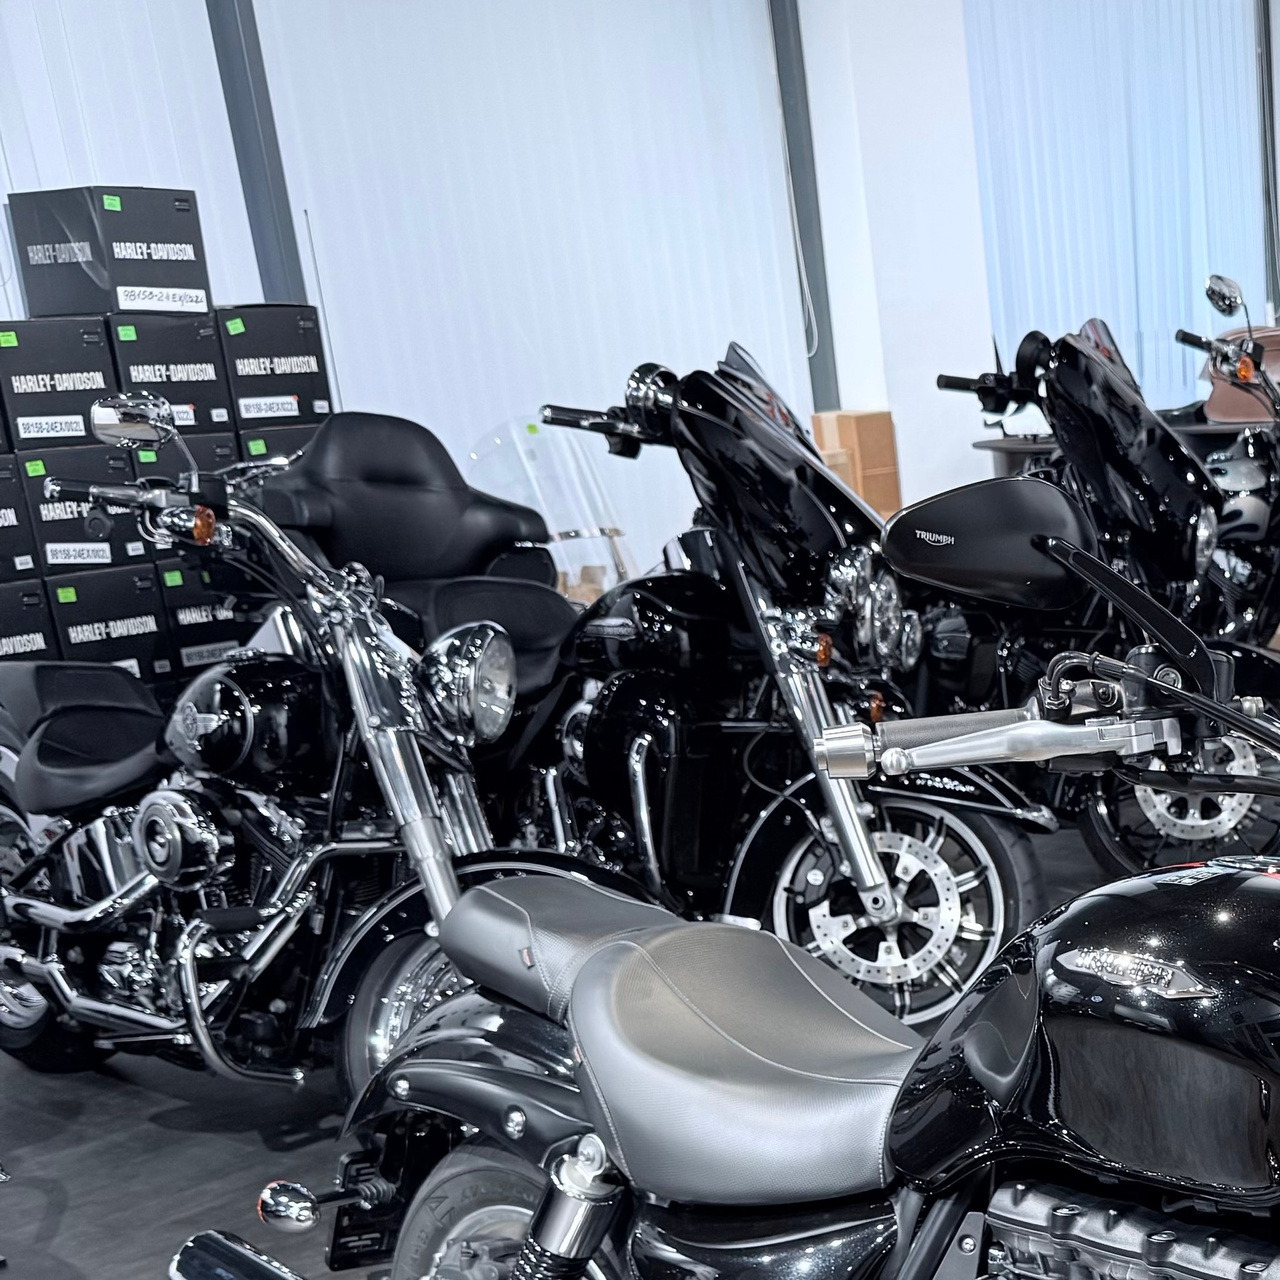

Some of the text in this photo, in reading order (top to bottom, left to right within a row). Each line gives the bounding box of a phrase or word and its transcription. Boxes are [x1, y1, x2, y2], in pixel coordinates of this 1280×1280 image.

[112, 241, 195, 261] HARLEY-DAVIDSON
[130, 363, 216, 383] HARLEY-DAVIDSON
[235, 356, 318, 376] HARLEY-DAVIDSON
[11, 371, 105, 393] HARLEY-DAVIDSON
[915, 530, 955, 545] TRIUMPH
[68, 615, 158, 644] HARLEY-DAVIDSON
